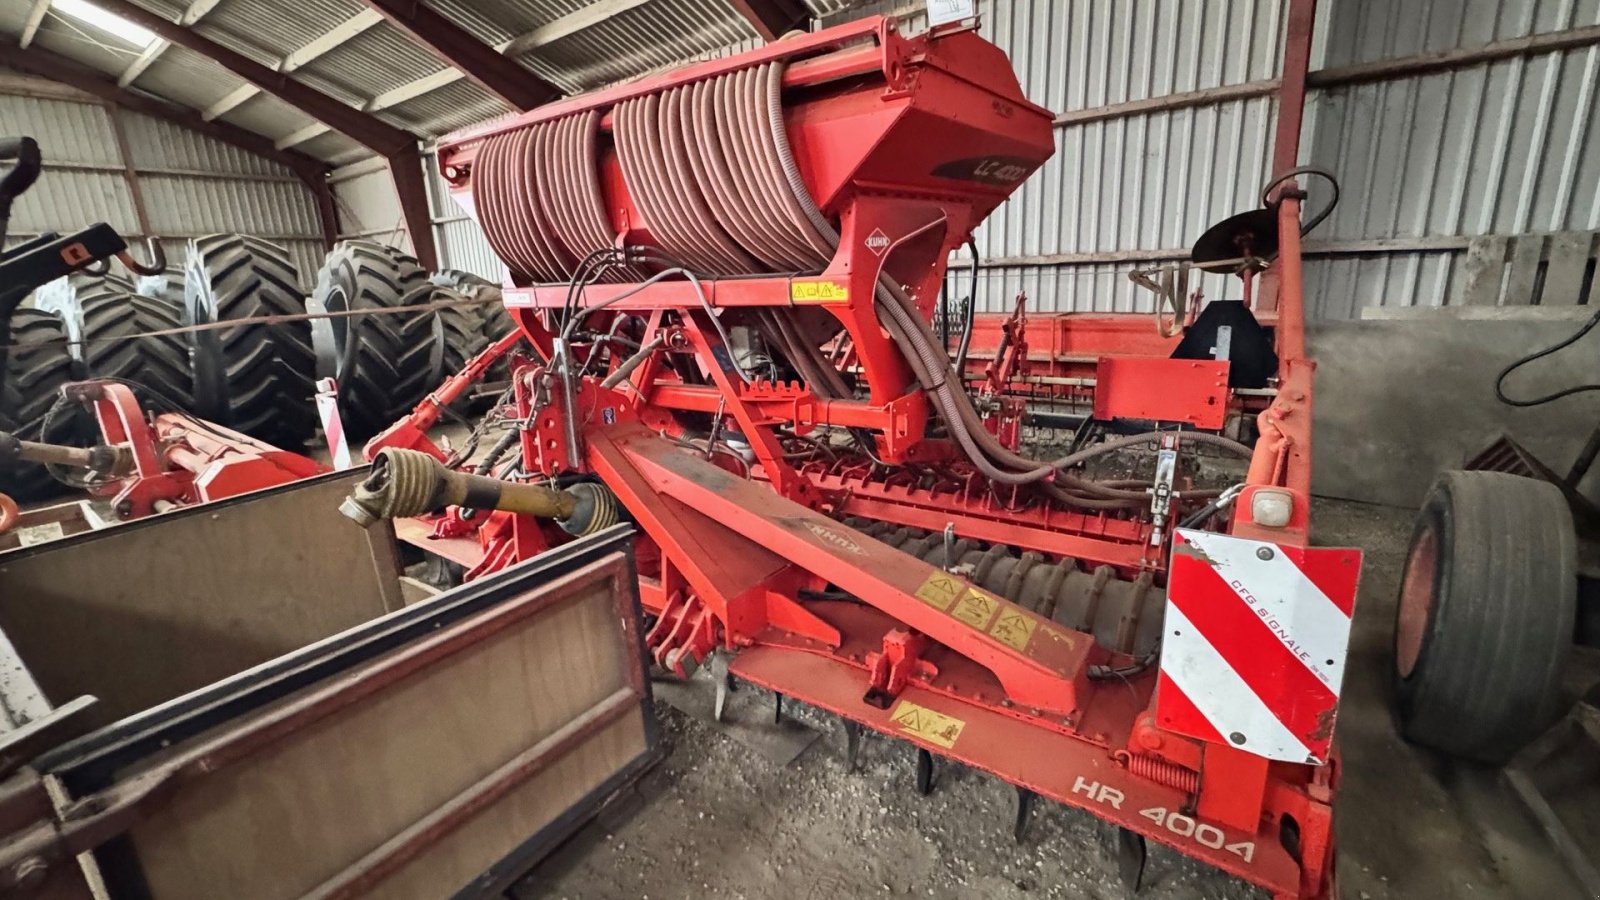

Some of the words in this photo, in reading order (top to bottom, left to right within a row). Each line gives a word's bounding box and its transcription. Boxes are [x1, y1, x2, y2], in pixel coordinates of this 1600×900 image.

[973, 159, 1000, 176] LC
[868, 236, 888, 247] KUHN
[810, 525, 864, 555] KUHN
[1231, 580, 1257, 605] CFG
[1257, 607, 1311, 661] SIGNALE
[1072, 776, 1125, 810] HR
[1138, 807, 1255, 863] 4004
